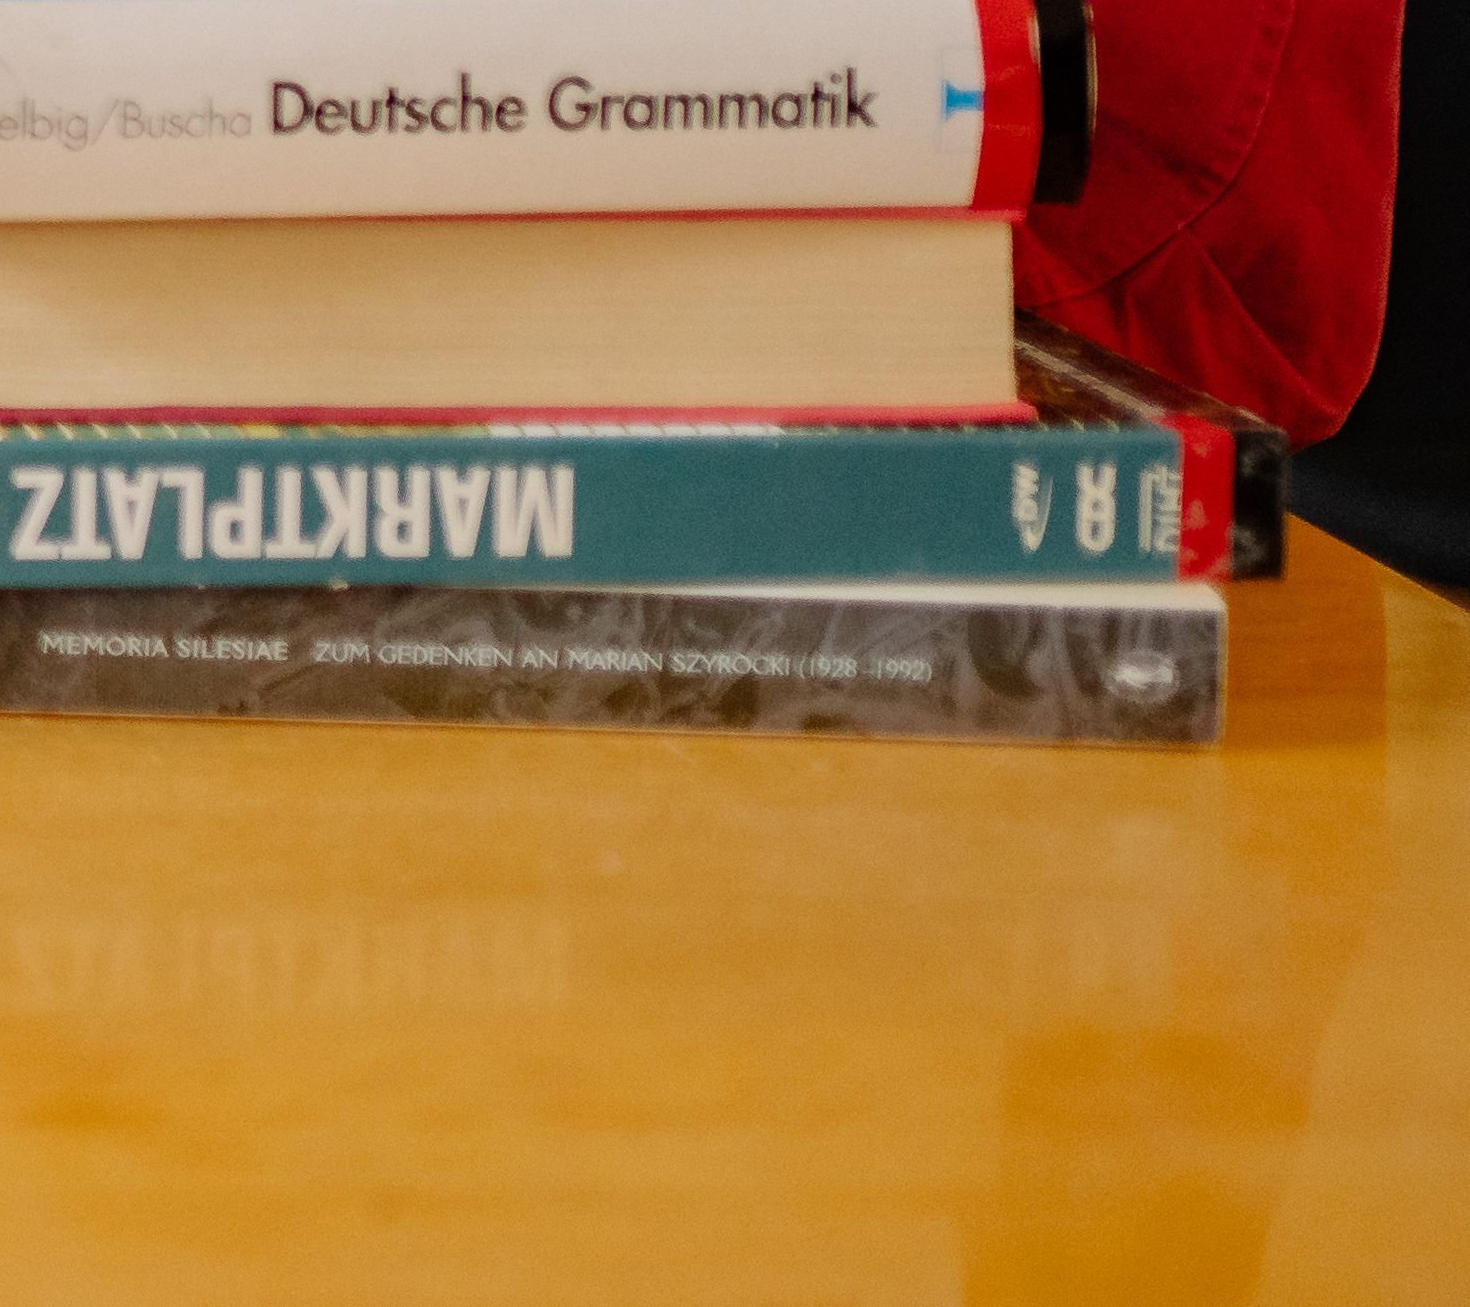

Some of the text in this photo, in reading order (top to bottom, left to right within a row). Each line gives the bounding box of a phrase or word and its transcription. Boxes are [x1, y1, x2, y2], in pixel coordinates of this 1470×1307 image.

[269, 68, 527, 137] Deutsche
[547, 66, 880, 133] Grammatik
[12, 464, 576, 561] MARKTPLATZ
[38, 632, 170, 658] MEMORIA
[175, 634, 289, 661] SILESIAE
[311, 639, 371, 664] ZUM
[377, 642, 513, 669] GEDENKEN
[521, 646, 558, 669] AN
[568, 647, 663, 673] MARIAN
[670, 650, 791, 676] SZYROCKI
